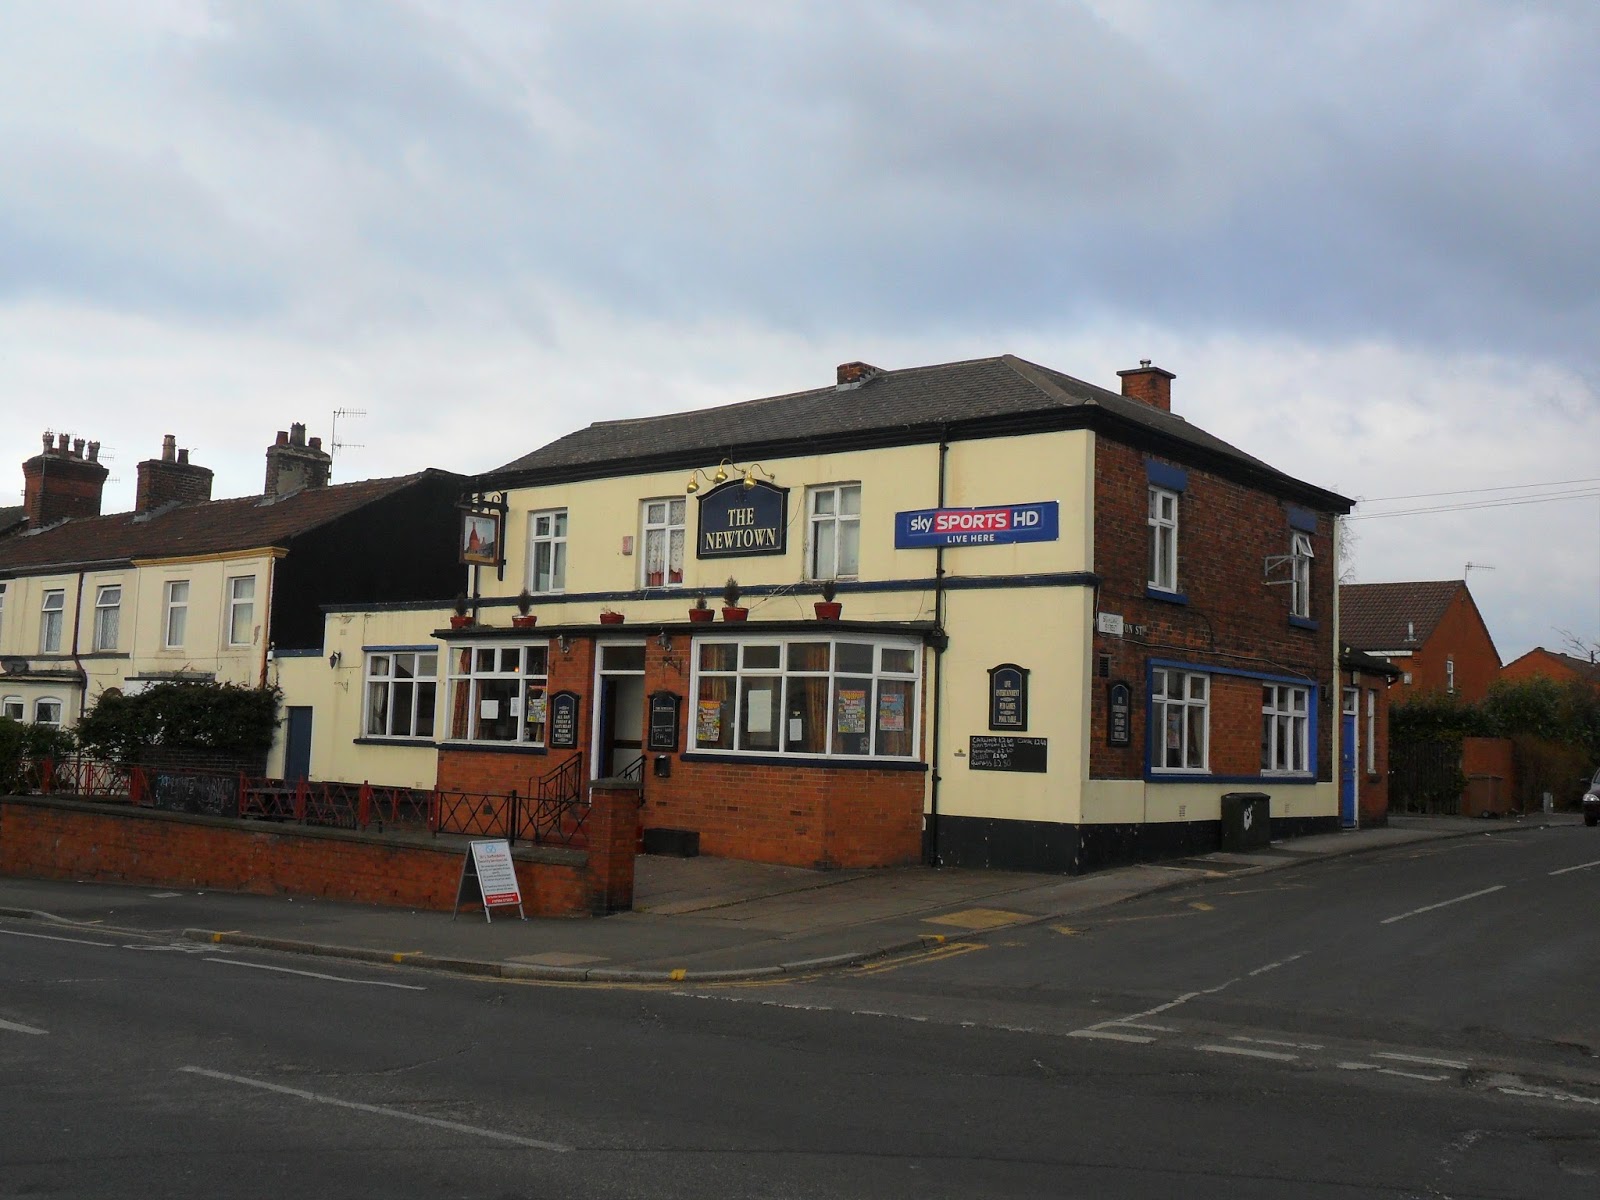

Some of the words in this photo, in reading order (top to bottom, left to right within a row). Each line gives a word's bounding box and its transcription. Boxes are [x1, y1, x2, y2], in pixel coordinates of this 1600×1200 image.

[727, 507, 755, 527] THE
[910, 515, 933, 533] sky
[936, 513, 1007, 530] SPORTS
[1013, 511, 1039, 527] HD
[705, 528, 776, 550] NEWTOWN
[947, 535, 968, 543] LIVE
[970, 534, 995, 543] HERE
